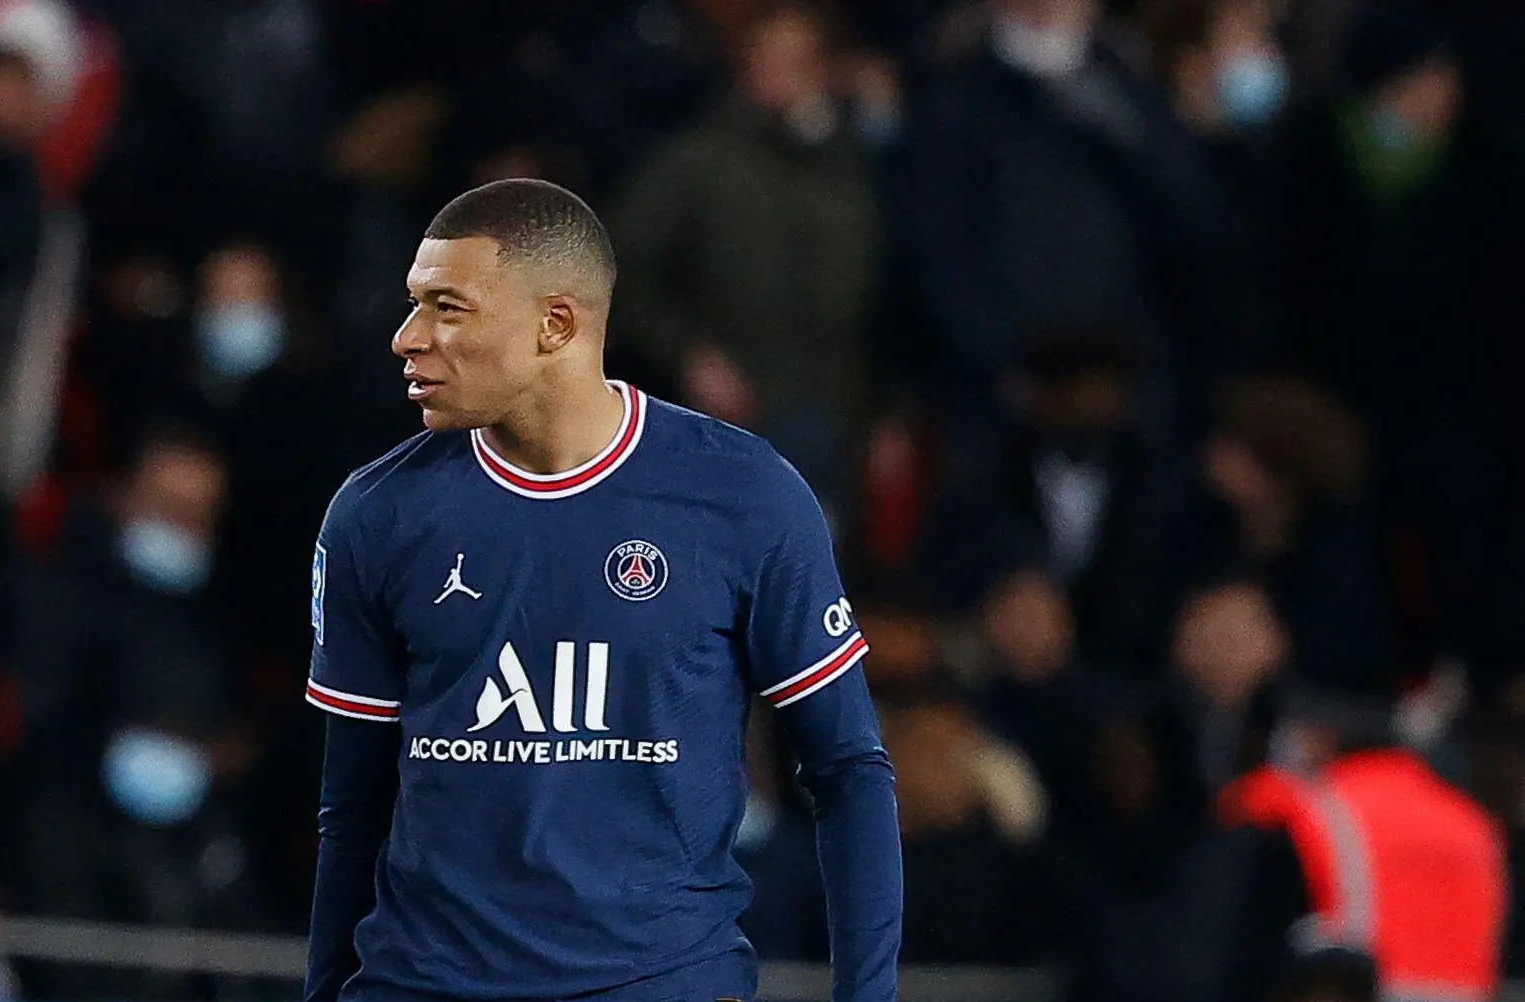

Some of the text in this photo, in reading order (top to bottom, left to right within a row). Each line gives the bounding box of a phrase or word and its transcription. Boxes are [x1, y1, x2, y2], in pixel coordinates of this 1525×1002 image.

[617, 544, 658, 560] PARIS
[409, 737, 678, 763] ACCOR LIVE LIMITLESS
